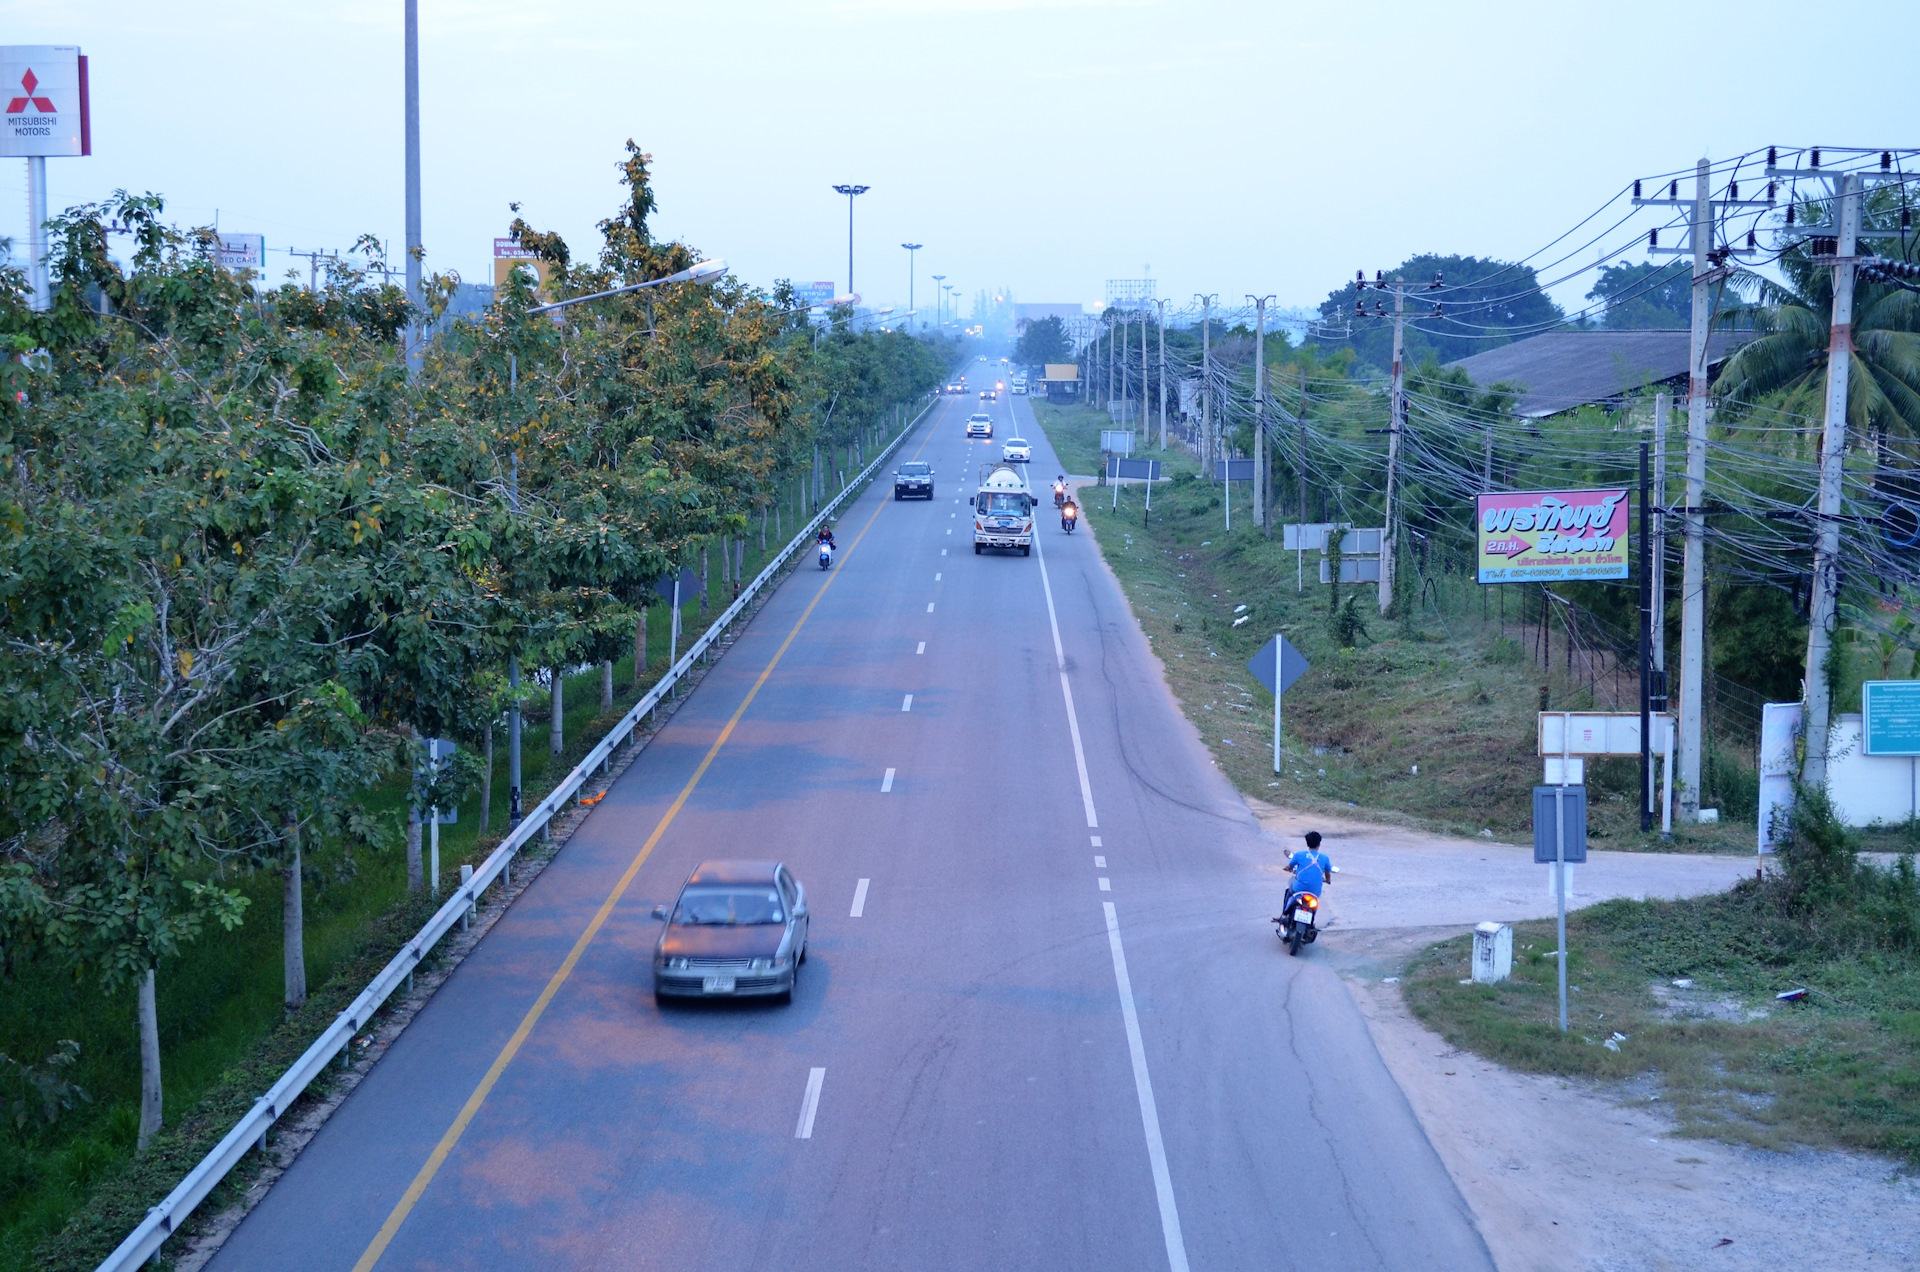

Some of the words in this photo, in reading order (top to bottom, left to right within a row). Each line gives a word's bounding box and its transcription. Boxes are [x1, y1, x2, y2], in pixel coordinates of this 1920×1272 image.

[8, 117, 57, 126] MITSUBISHI
[15, 127, 51, 136] MOTORS
[236, 256, 257, 264] CARS
[1483, 491, 1627, 533] พรทิพย์
[1536, 527, 1615, 554] รีสอร์ท
[1578, 556, 1592, 565] 24
